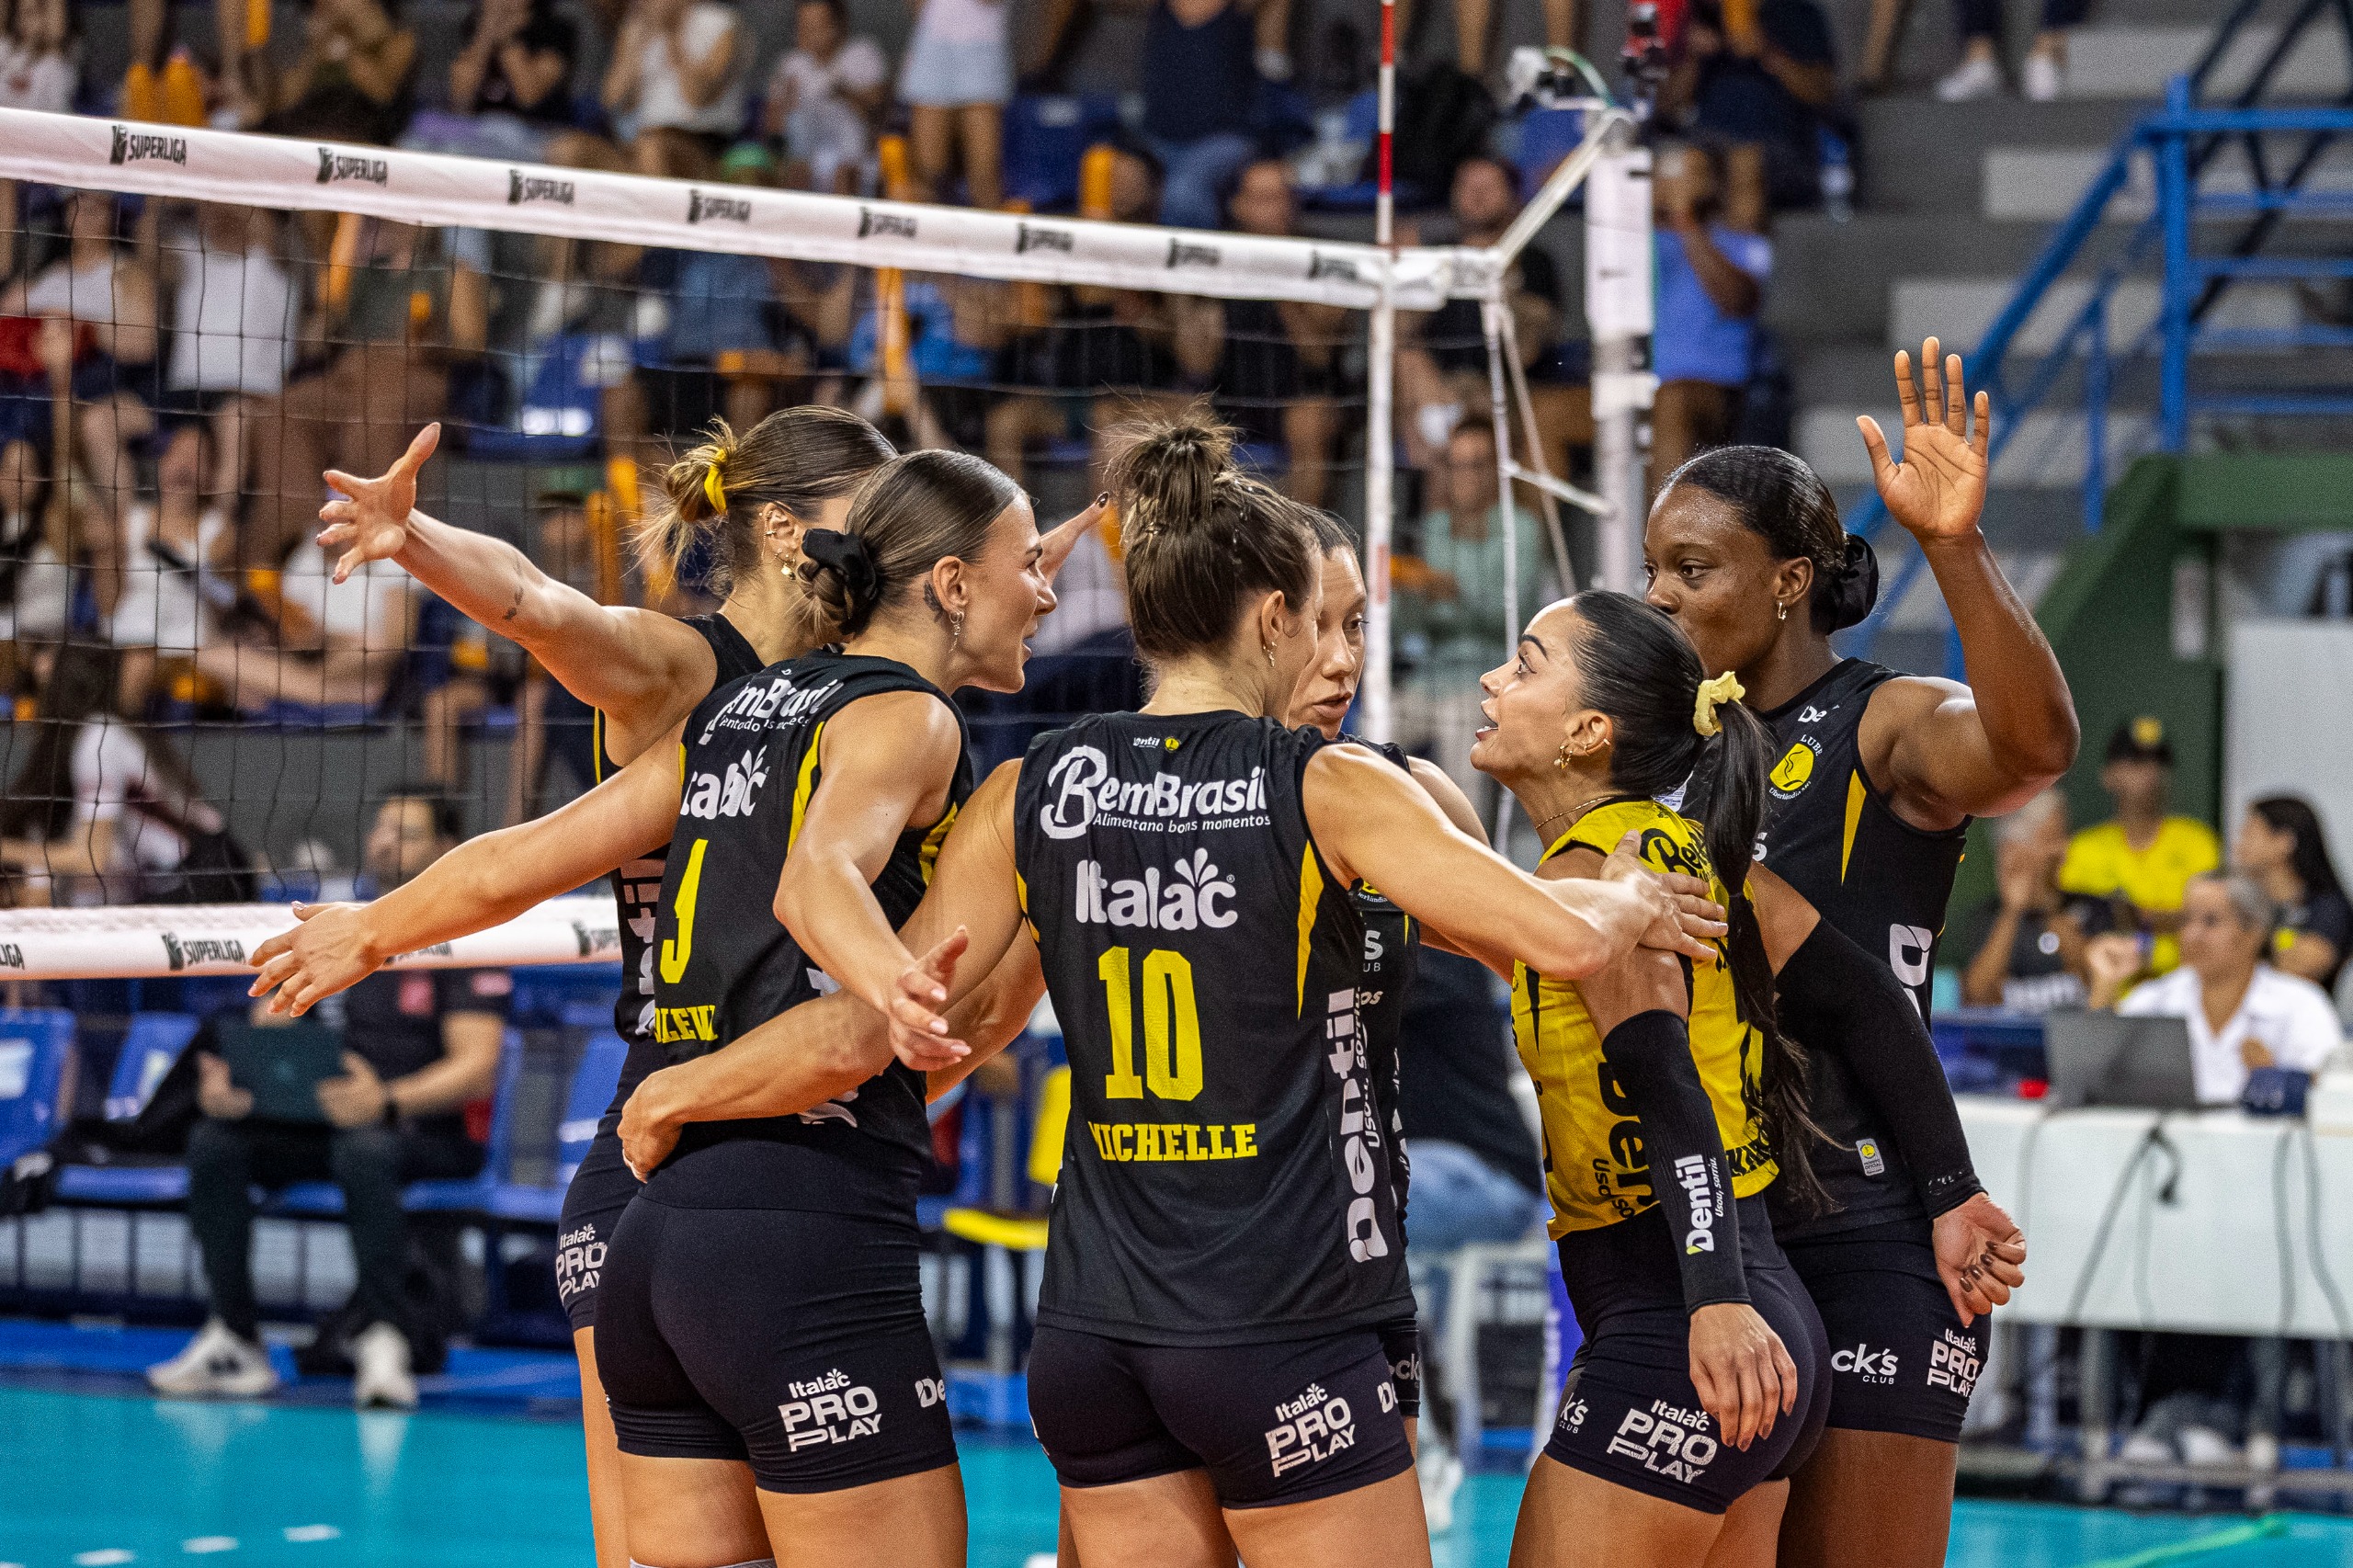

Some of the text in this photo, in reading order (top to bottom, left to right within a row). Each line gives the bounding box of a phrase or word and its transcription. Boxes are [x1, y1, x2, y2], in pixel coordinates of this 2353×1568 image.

[127, 133, 187, 166] SUPERLIGA
[334, 154, 389, 187] SUPERLIGA
[1040, 744, 1267, 840] BemBrasil
[1202, 814, 1271, 831] momentos
[1075, 855, 1239, 931] Italac
[184, 939, 246, 966] SUPERLIGA
[1098, 946, 1204, 1102] 10
[1326, 987, 1389, 1264] Dentil
[1674, 1153, 1715, 1256] Dentil
[559, 1224, 597, 1251] Italac
[555, 1242, 608, 1288] PRO
[1930, 1339, 1981, 1382] PRO
[1945, 1328, 1977, 1357] Italac
[788, 1369, 851, 1399] Italac
[1862, 1375, 1895, 1385] CLUB
[778, 1385, 878, 1433] PRO
[1275, 1384, 1328, 1423] Italac
[1651, 1399, 1711, 1432] Italac
[788, 1413, 882, 1452] PLAY
[1265, 1396, 1351, 1460] PRO
[1617, 1407, 1718, 1466] PRO
[1272, 1424, 1356, 1478] PLAY
[1606, 1435, 1706, 1484] PLAY
